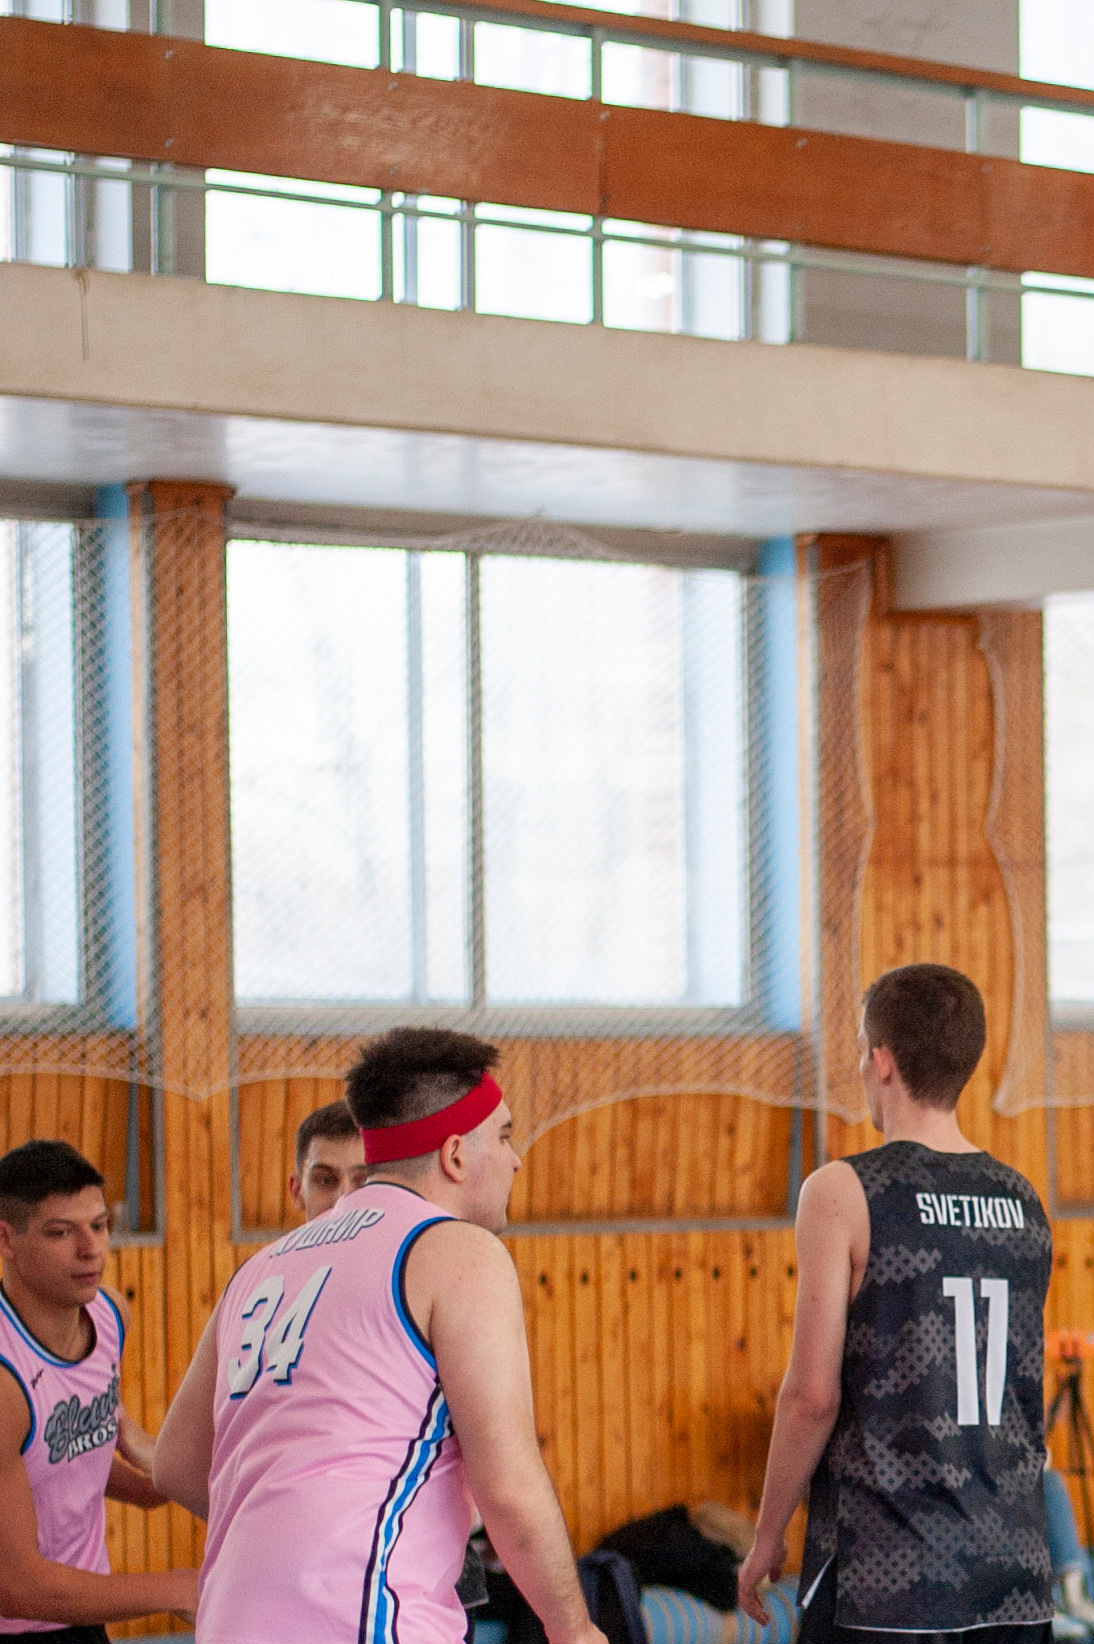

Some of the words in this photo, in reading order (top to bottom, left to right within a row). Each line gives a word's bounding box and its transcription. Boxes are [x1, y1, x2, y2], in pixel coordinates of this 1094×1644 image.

[915, 1192, 1025, 1229] SVETIKOV
[227, 1264, 333, 1399] 34
[942, 1276, 1009, 1426] 11
